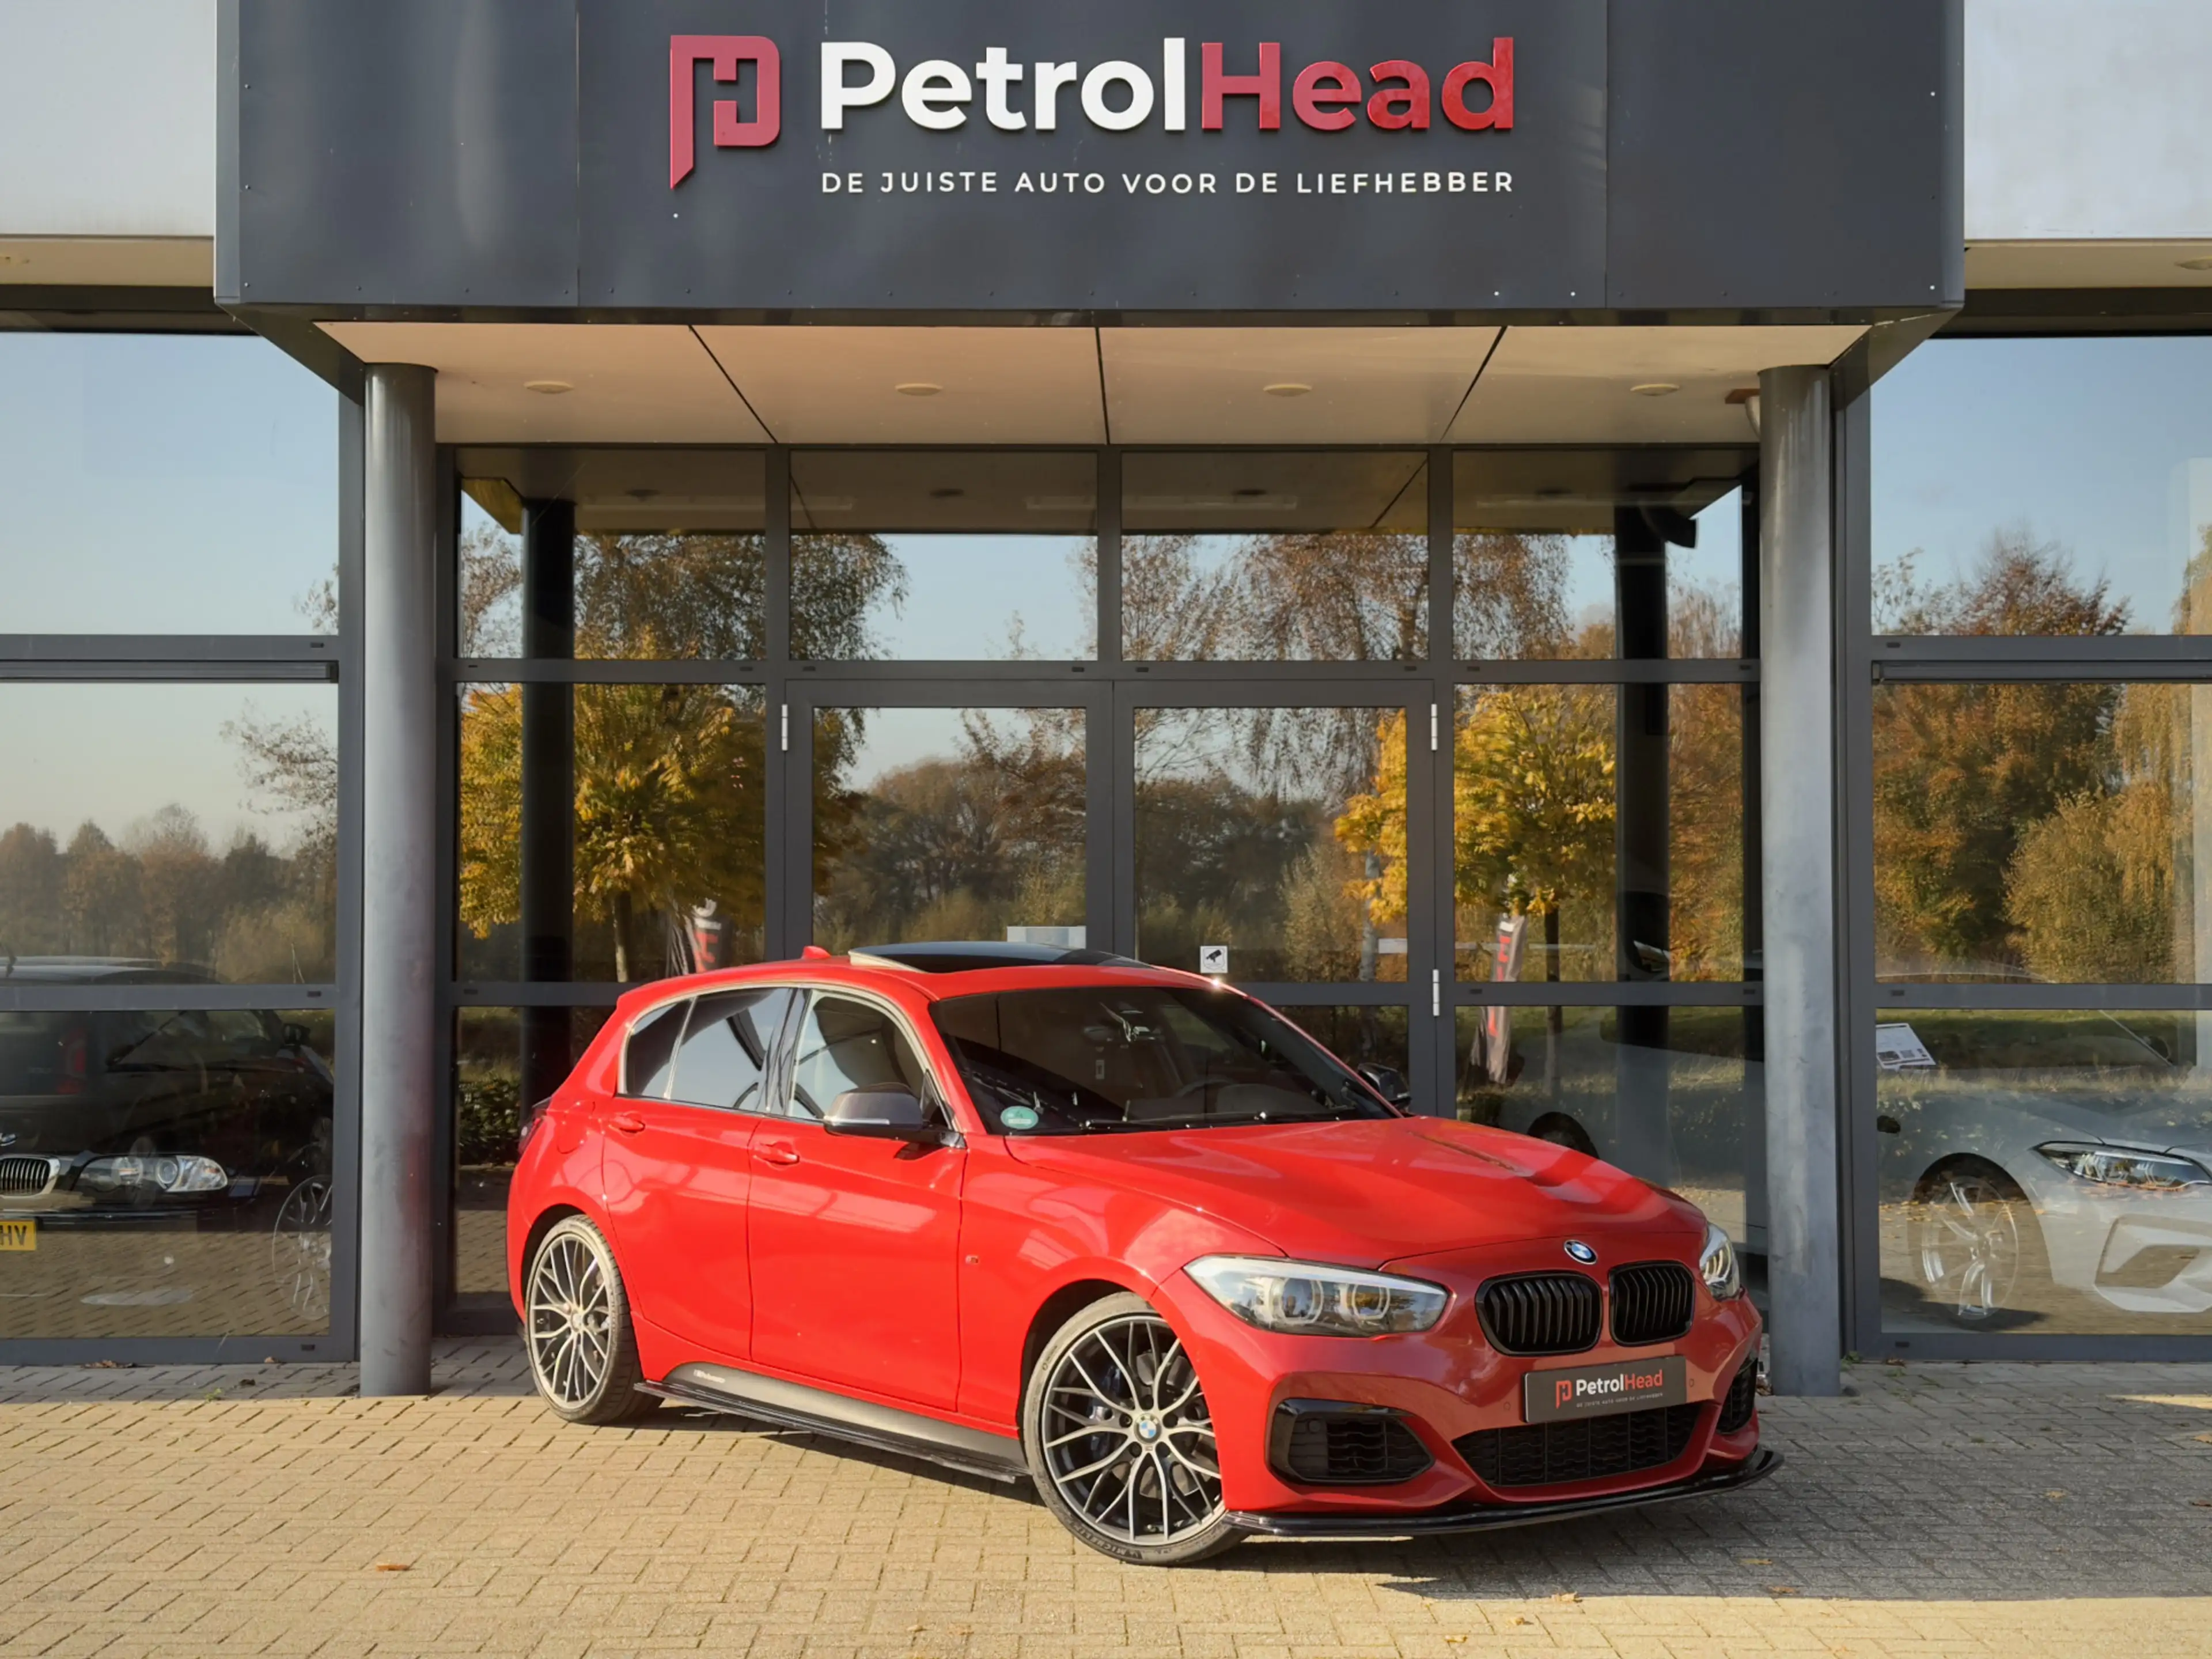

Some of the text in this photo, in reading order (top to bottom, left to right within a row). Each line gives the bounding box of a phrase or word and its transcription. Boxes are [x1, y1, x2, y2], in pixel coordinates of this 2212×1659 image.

[821, 37, 1514, 131] PetrolHead
[822, 172, 1513, 194] DE JUISTE AUTO VOOR DE LIEFHEBBER
[1576, 1369, 1663, 1396] PetrolHead
